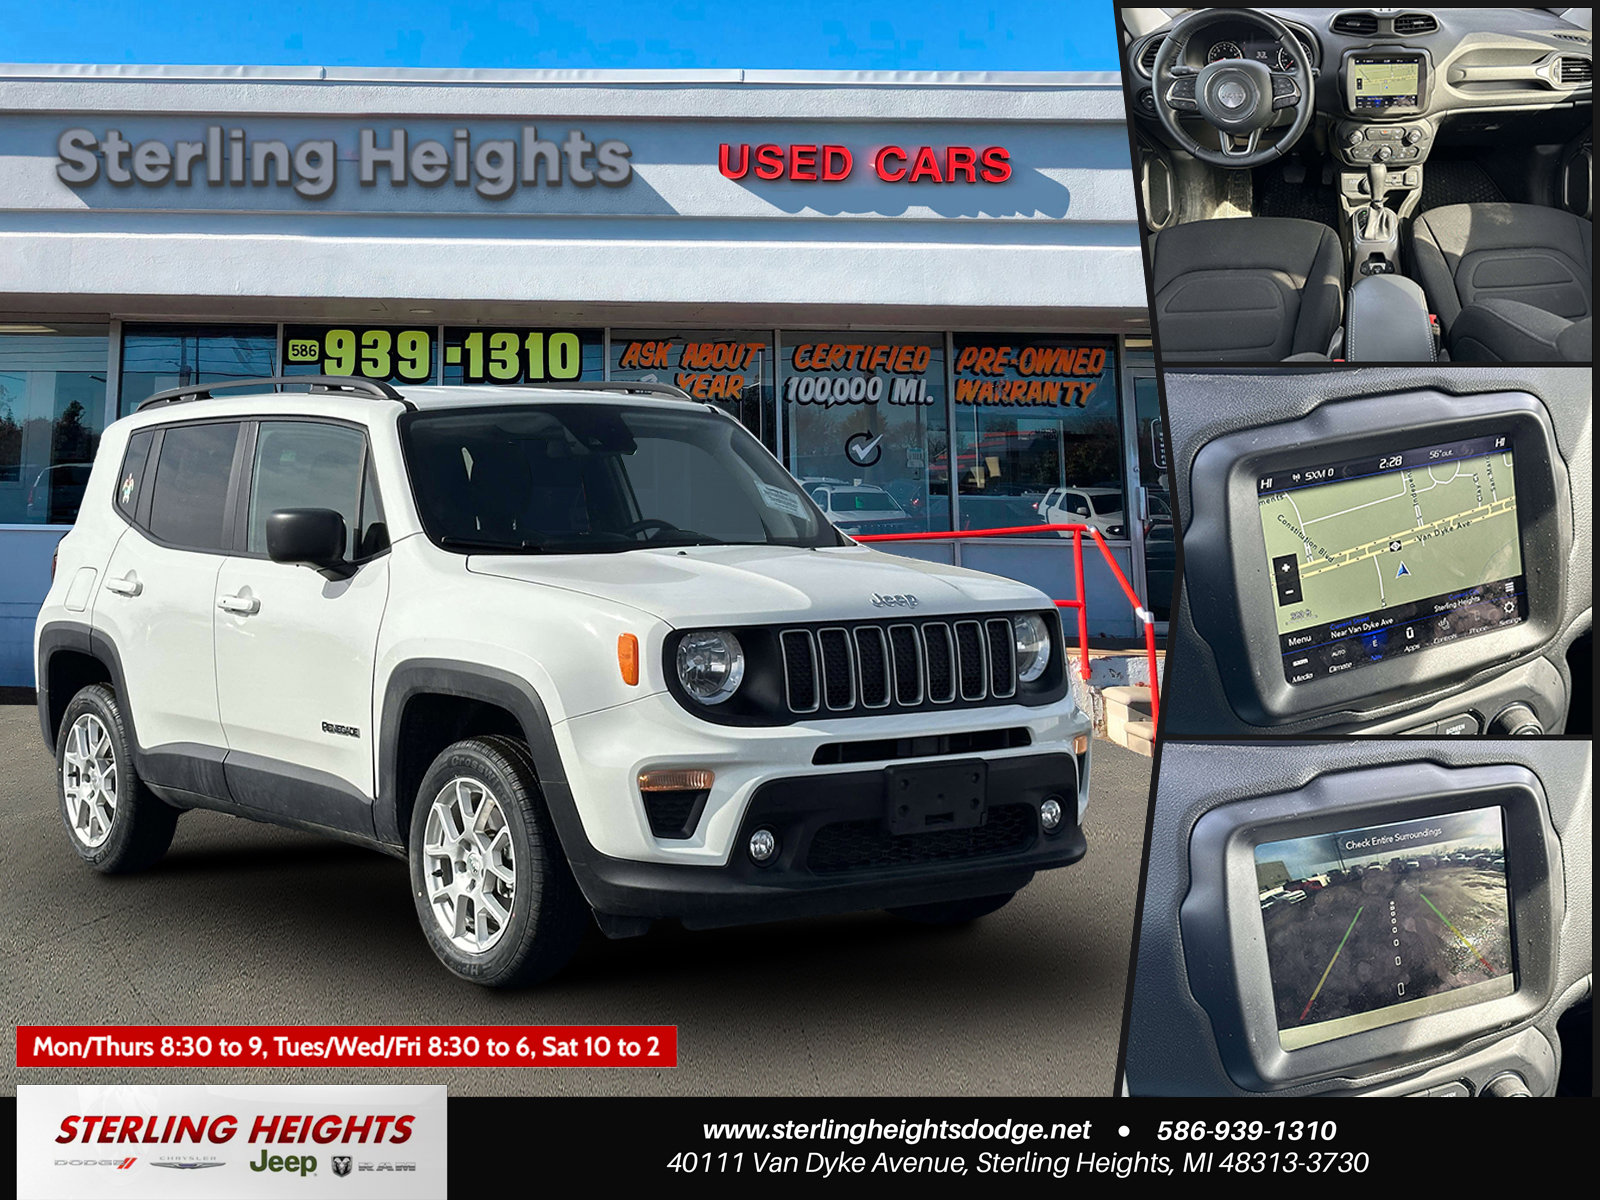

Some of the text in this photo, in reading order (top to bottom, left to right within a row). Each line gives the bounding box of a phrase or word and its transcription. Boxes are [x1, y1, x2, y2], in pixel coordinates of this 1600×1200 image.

[56, 125, 634, 201] Sterling Heights
[718, 143, 1013, 184] USED CARS
[290, 342, 318, 358] 586
[323, 329, 430, 378] 939
[620, 341, 766, 371] ASK ABOUT
[793, 343, 931, 374] CERTIFIED
[954, 346, 1106, 378] PRE-OWNED
[674, 372, 745, 402] YEAR
[784, 376, 935, 409] 100,000 MI.
[955, 378, 1097, 408] WARRANTY
[1494, 436, 1506, 448] HI
[1378, 455, 1403, 470] 2:28
[1260, 478, 1273, 489] HI
[1304, 470, 1327, 482] SXM
[1276, 513, 1336, 564] Constitution Blvd
[1416, 520, 1471, 543] Van Dyke Ave
[868, 591, 920, 610] Jeep
[1433, 595, 1481, 613] Sterling Heights
[1330, 617, 1394, 639] Near Van Dyke Ave
[1288, 634, 1313, 647] Menu
[1403, 643, 1421, 653] Apps
[1291, 671, 1314, 684] Media
[1345, 826, 1443, 851] Check Entire Surroundings
